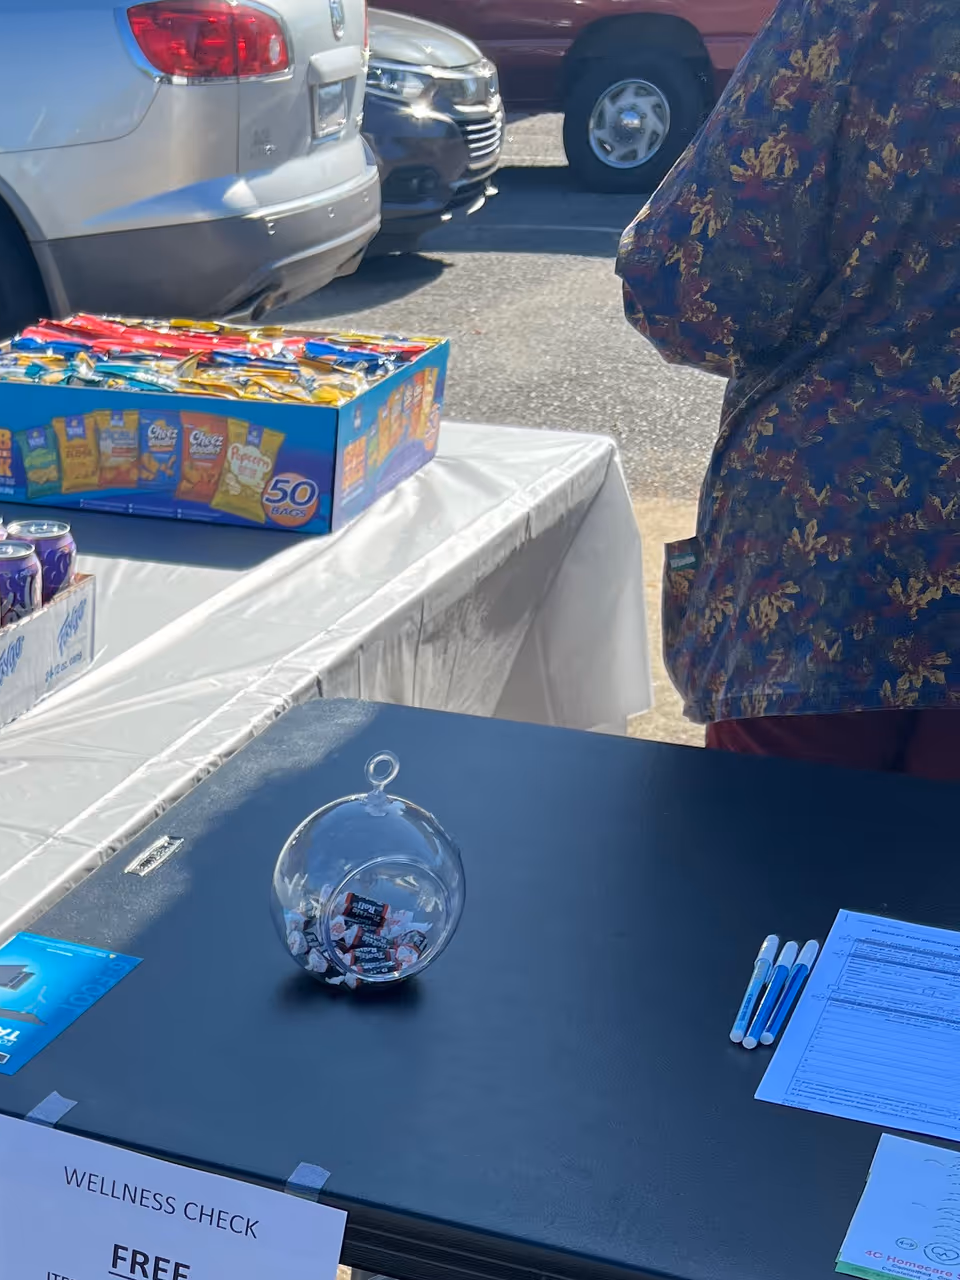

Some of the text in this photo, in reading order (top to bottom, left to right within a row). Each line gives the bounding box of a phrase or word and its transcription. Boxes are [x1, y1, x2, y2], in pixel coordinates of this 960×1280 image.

[148, 425, 178, 442] Cheez
[190, 430, 224, 446] Cheez
[230, 446, 271, 469] Popcorn
[262, 477, 319, 508] 50
[271, 506, 307, 518] BAGS
[57, 599, 87, 656] Faygo
[64, 1166, 259, 1239] WELLNESS CHECK
[865, 1249, 884, 1259] 4C
[886, 1255, 953, 1278] Homecare
